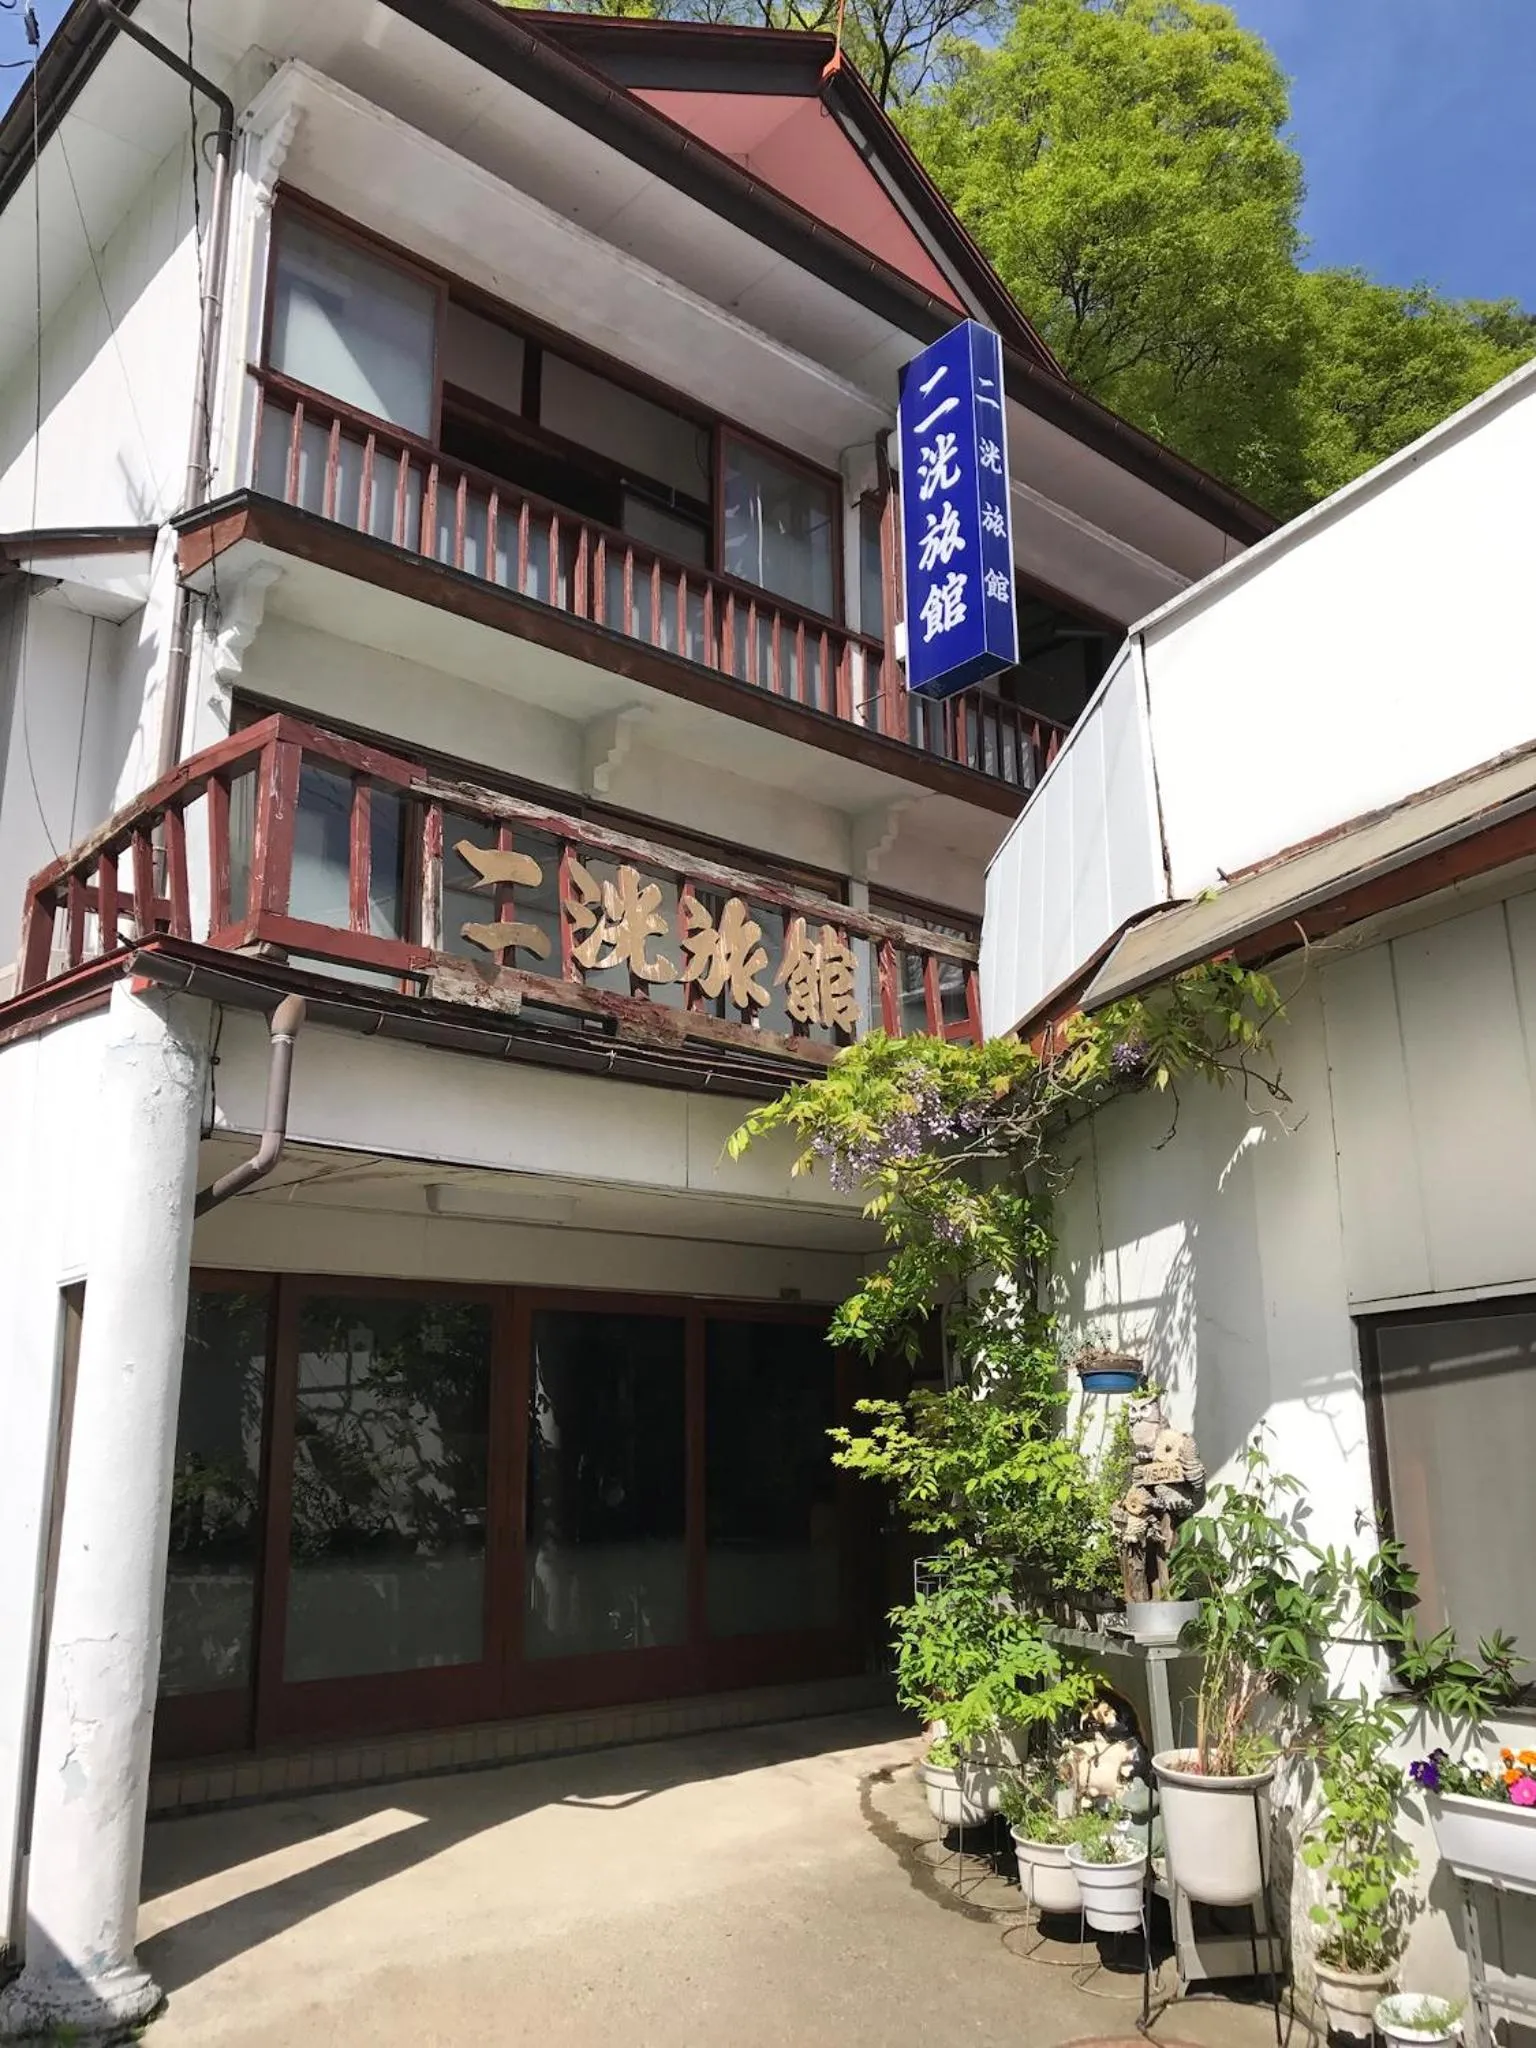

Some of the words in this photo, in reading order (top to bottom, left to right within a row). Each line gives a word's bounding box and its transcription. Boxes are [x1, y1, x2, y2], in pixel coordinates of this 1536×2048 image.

[914, 366, 967, 643] 二洸旅館
[975, 376, 1010, 602] 二洸旅館
[453, 839, 863, 1033] 二洸旅館
